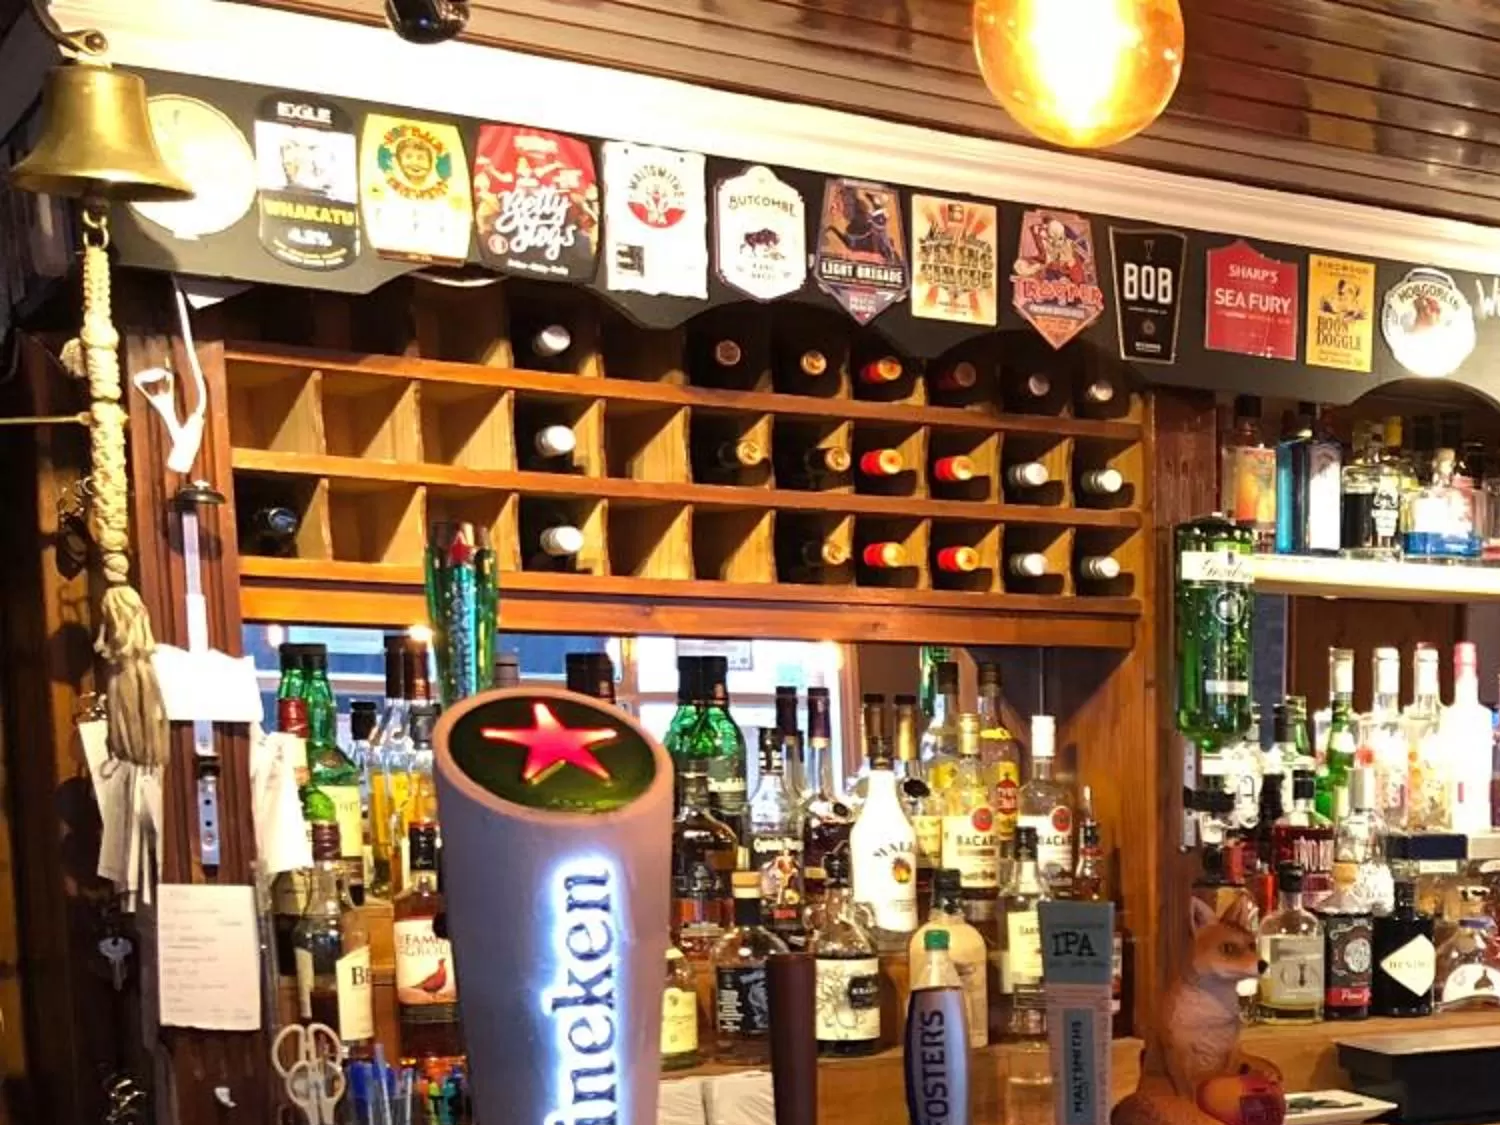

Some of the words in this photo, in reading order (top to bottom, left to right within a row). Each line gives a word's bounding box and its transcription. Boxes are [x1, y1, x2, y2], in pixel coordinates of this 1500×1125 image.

[263, 199, 356, 227] WHAKATU
[728, 194, 797, 217] BUTCOMBE
[821, 259, 853, 278] LIGHT
[856, 263, 904, 284] BRIGADE
[1123, 262, 1173, 305] BOB
[1228, 264, 1279, 284] SHARP'S
[1214, 287, 1249, 309] SEA
[1249, 292, 1292, 316] FURY
[1052, 931, 1098, 957] IPA
